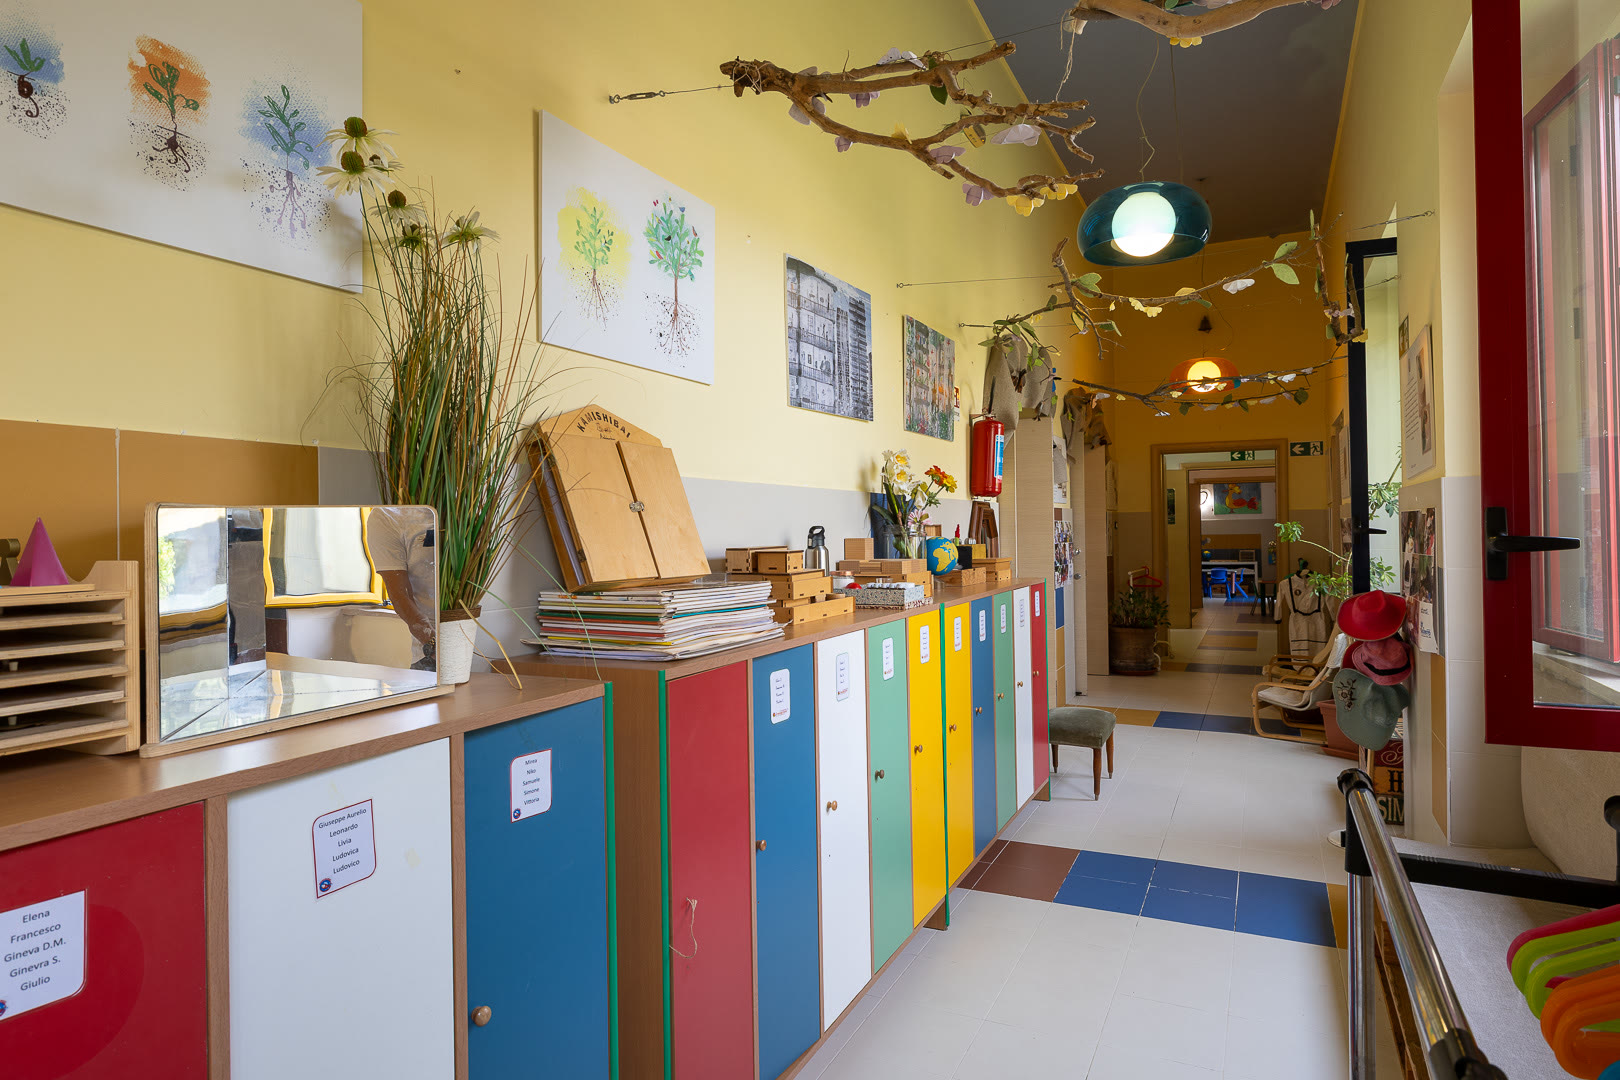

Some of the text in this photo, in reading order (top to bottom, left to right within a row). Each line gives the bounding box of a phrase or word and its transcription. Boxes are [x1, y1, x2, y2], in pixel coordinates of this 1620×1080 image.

[576, 411, 631, 438] KAMISHIBAI
[523, 788, 540, 796] Simone
[523, 797, 540, 805] Vittoria
[318, 808, 367, 829] Giuseppe Aurelio
[329, 822, 359, 838] Leonardo
[337, 837, 352, 847] Livia
[332, 847, 359, 862] Ludovica
[333, 859, 360, 874] Ludovico
[22, 910, 51, 923] Elena
[10, 923, 61, 944] Francesco
[4, 937, 67, 962] Gineva D.M.
[9, 955, 61, 978] Ginevra S.
[20, 976, 51, 991] Giulio
